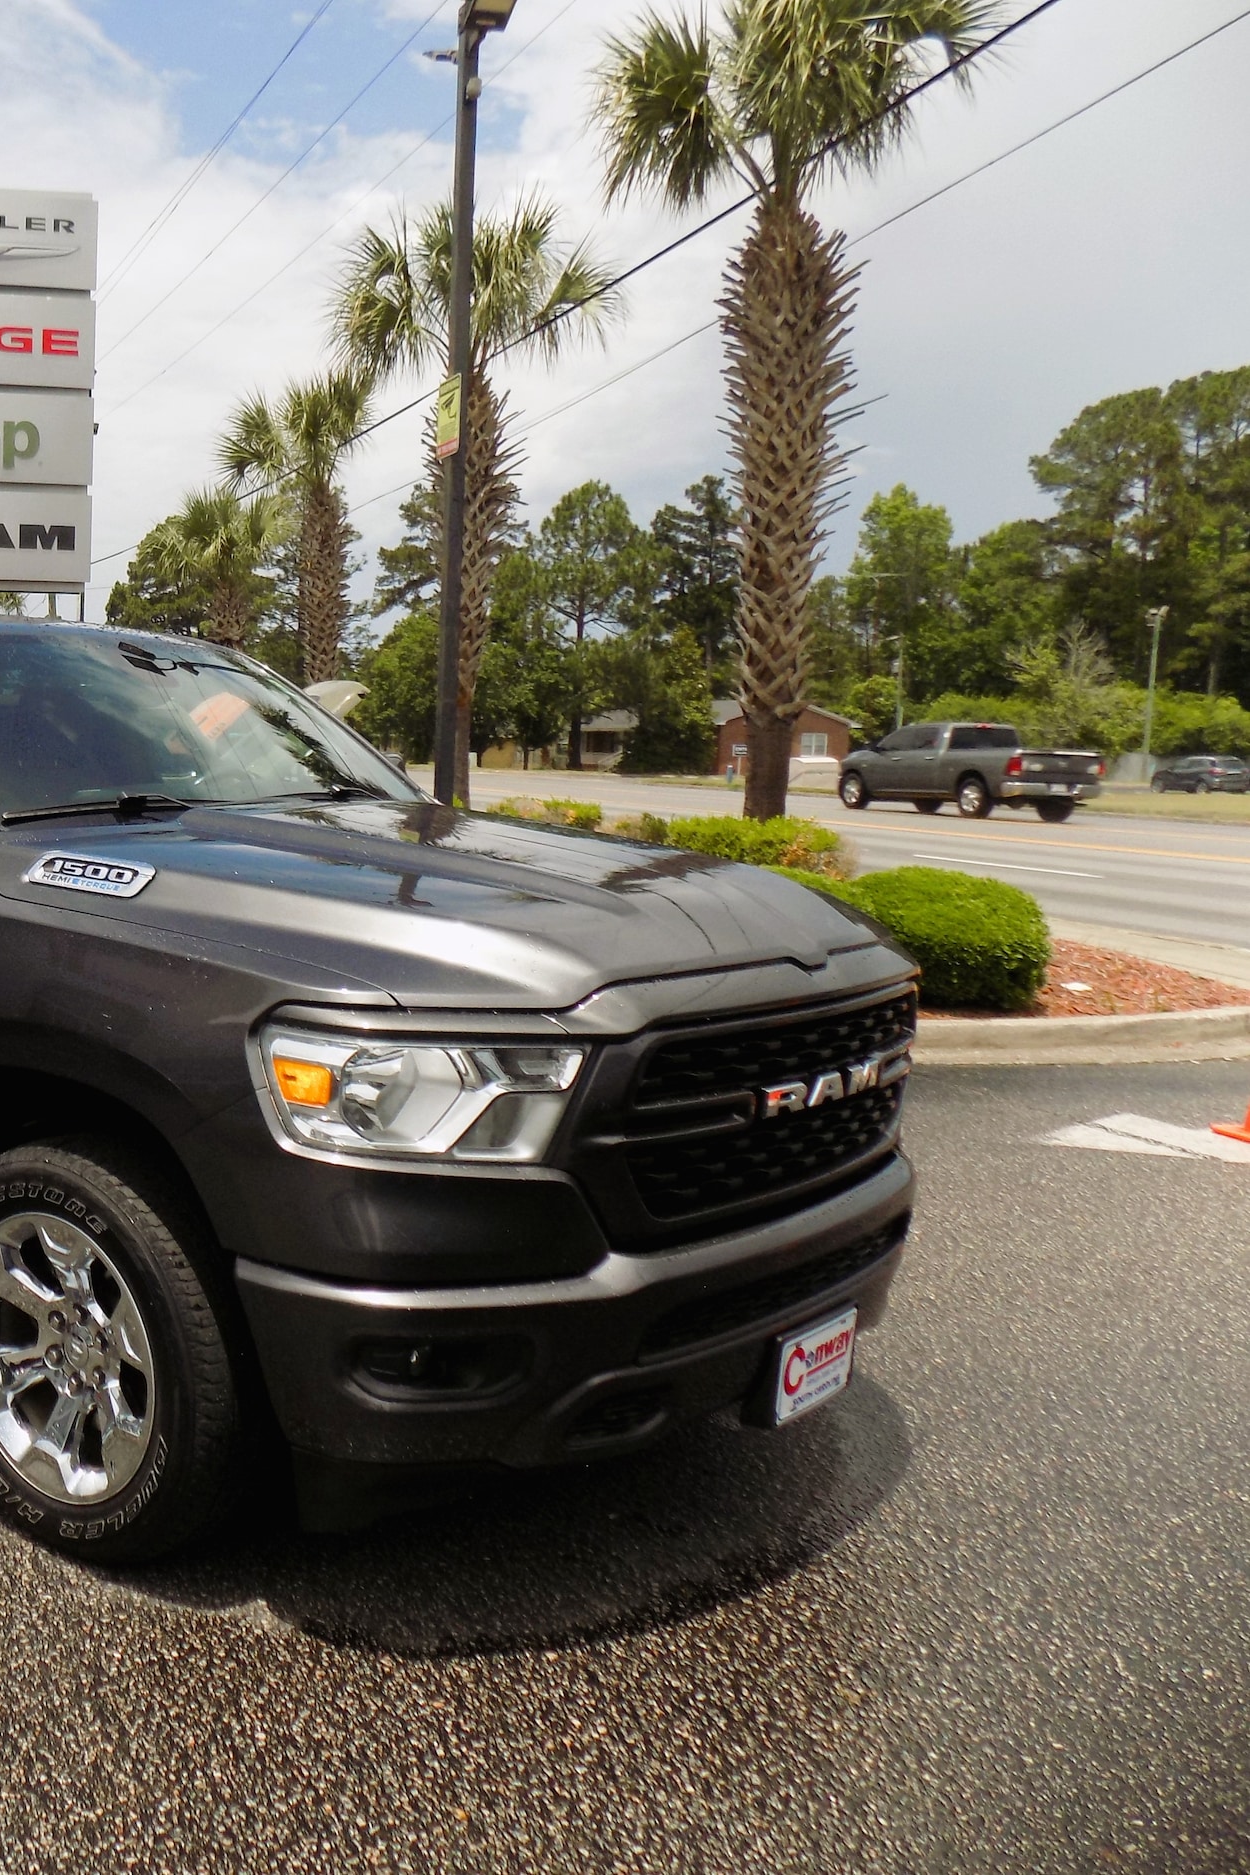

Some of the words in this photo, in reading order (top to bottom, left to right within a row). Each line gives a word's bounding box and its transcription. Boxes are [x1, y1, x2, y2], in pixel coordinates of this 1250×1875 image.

[41, 873, 71, 883] HEMI
[52, 859, 134, 884] 1500
[760, 1058, 882, 1120] RAM
